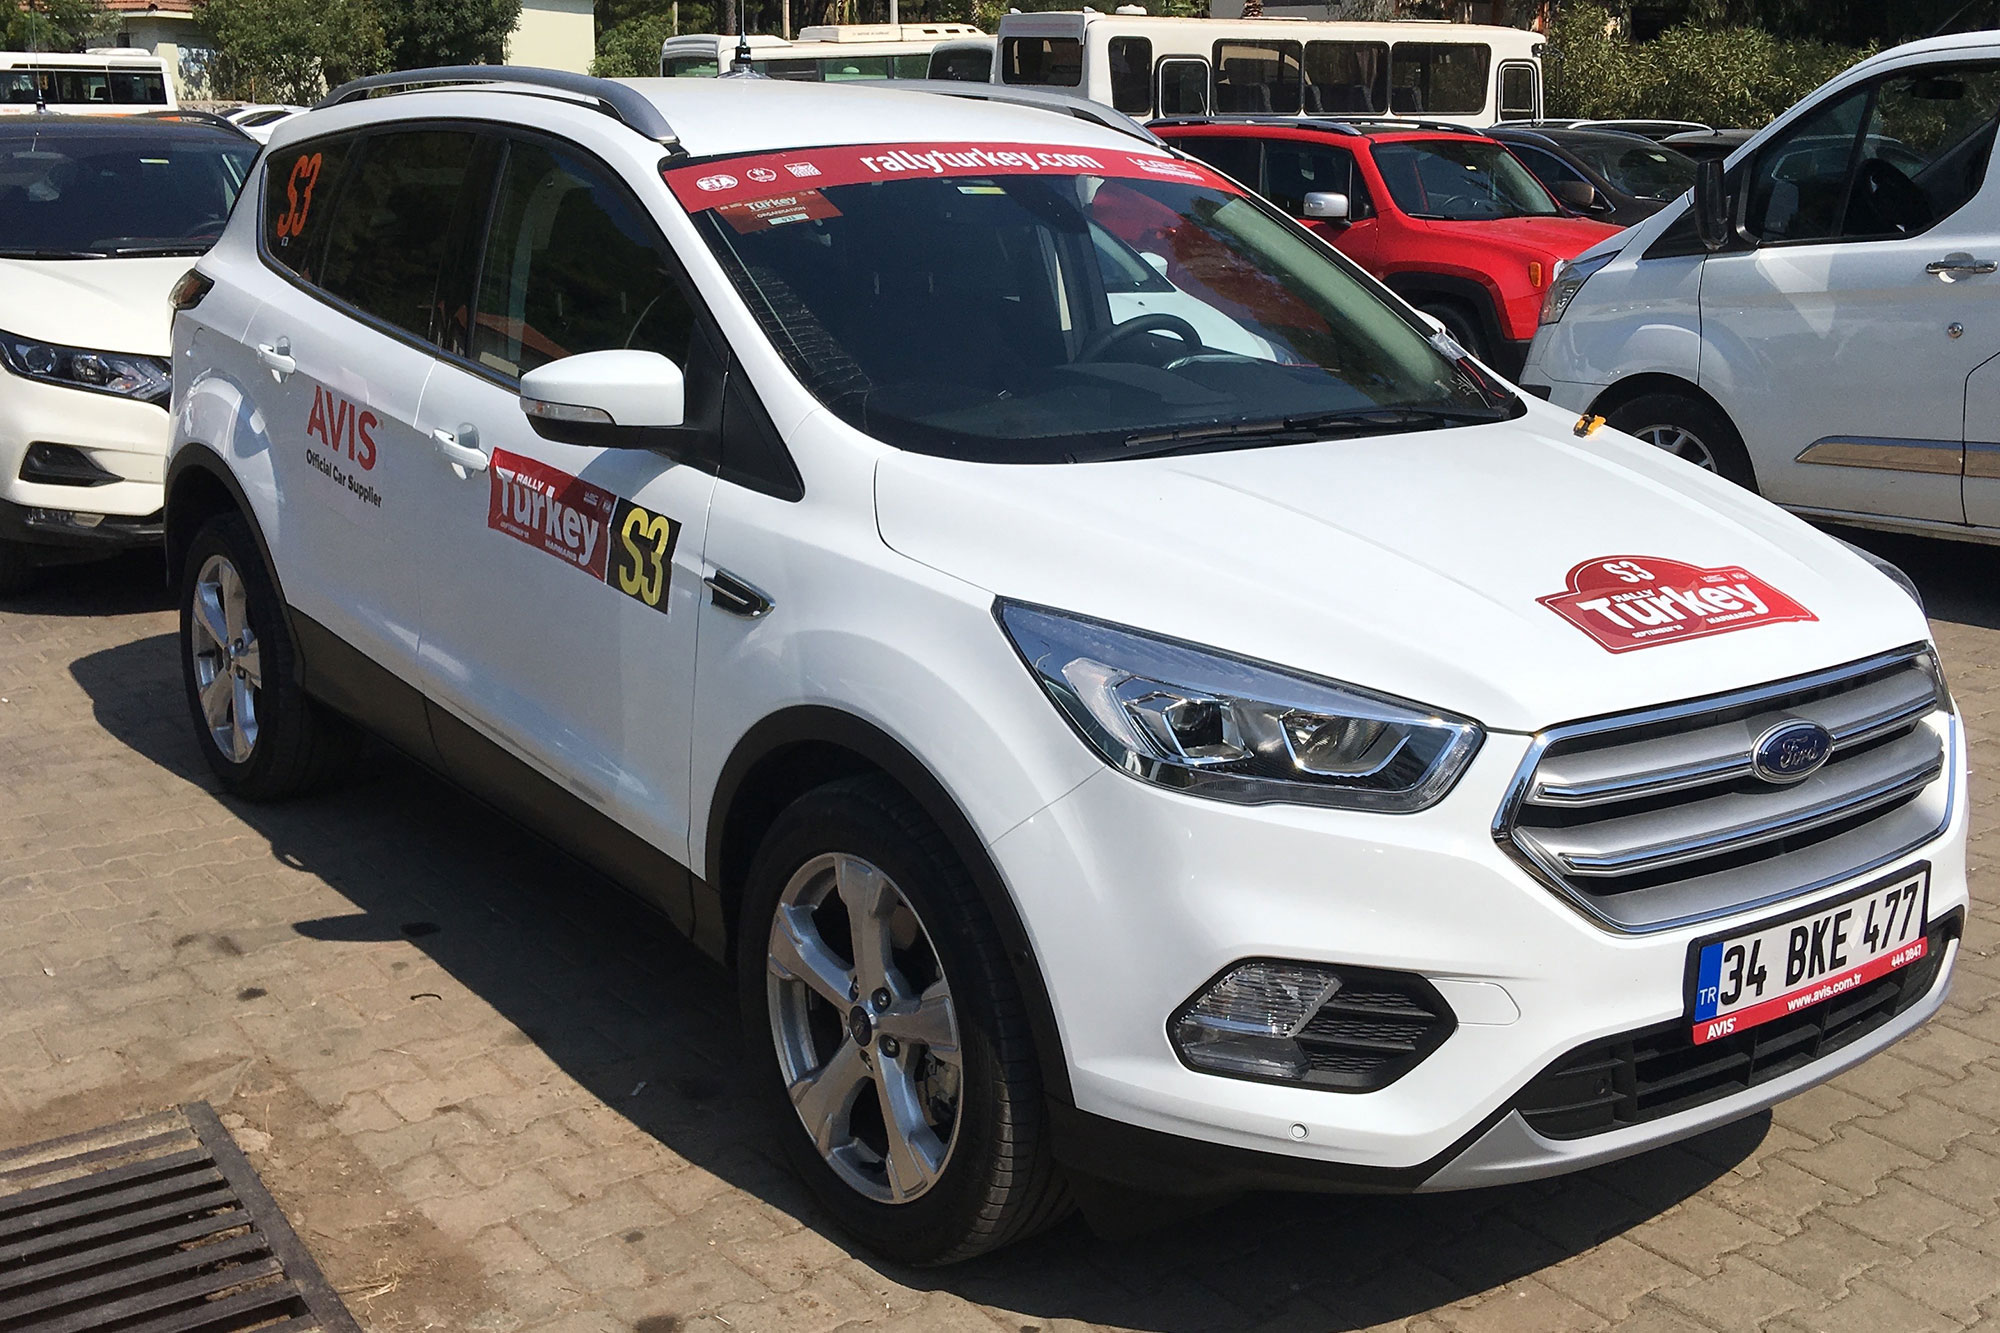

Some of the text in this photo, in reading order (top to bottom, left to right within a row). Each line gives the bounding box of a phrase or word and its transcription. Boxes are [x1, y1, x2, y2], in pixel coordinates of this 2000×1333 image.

[860, 148, 1104, 173] rallyturkey.com
[277, 153, 321, 237] S3
[746, 197, 797, 210] Turkey
[756, 206, 806, 218] ORGANISATION
[307, 385, 377, 471] AVIS
[306, 449, 382, 507] Official Car Supplier
[516, 473, 545, 492] RALLY
[496, 466, 599, 566] Turkey
[619, 507, 669, 606] S3
[1602, 560, 1656, 583] S3
[1576, 583, 1769, 629] Turkey
[1610, 588, 1656, 603] RALLY
[1780, 736, 1819, 768] Ford
[1720, 881, 1919, 1006] 34 BKE 477
[1891, 944, 1922, 968] 444 2847
[1700, 987, 1717, 1006] TR
[1787, 973, 1862, 1011] www.avis.com.tr
[1706, 1018, 1734, 1040] AVIS
